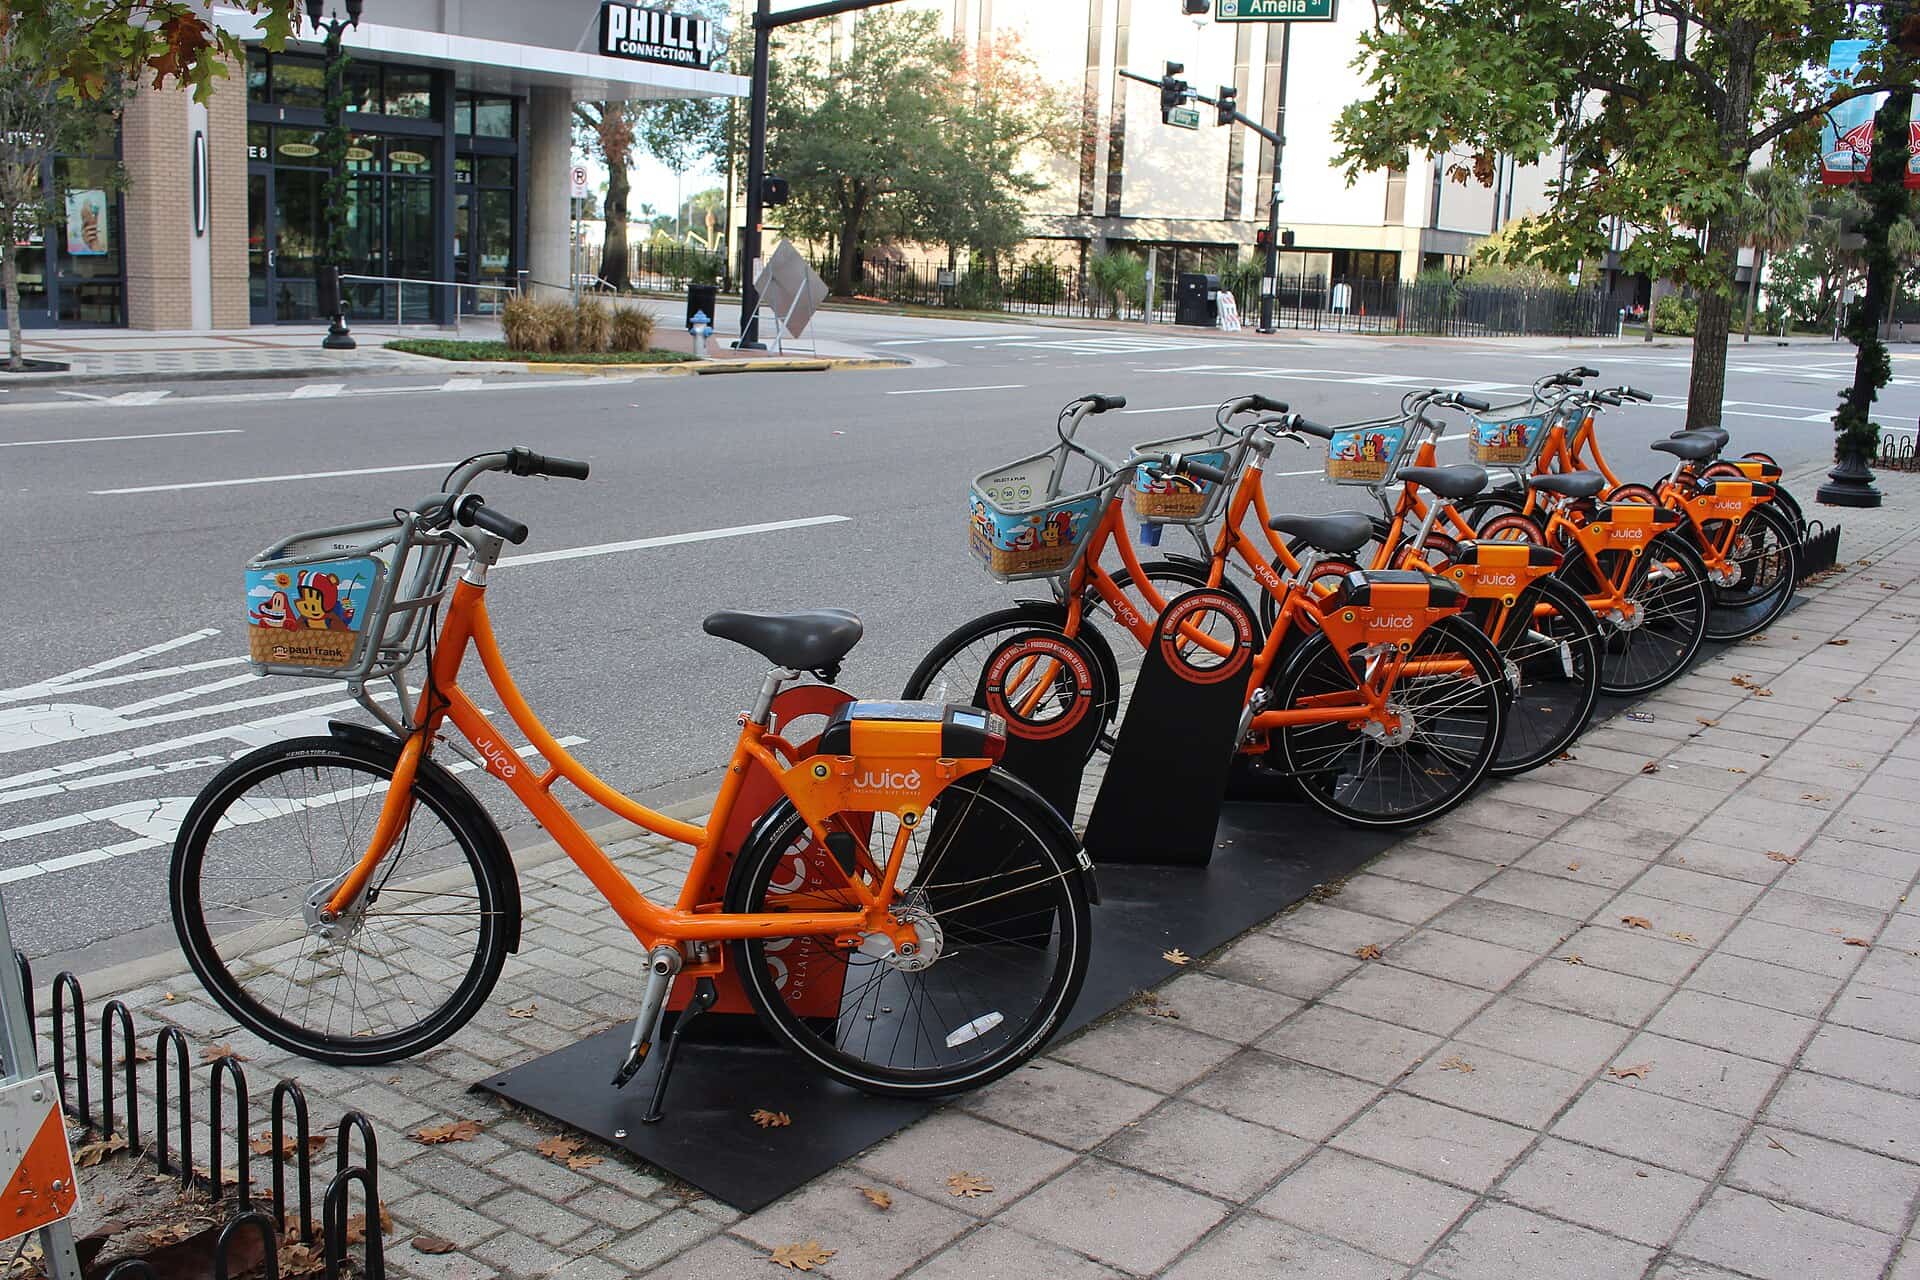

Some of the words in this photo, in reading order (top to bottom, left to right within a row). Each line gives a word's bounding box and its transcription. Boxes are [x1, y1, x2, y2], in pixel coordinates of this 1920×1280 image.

[1249, 0, 1307, 13] Amelia
[607, 4, 713, 65] PHILLY
[620, 41, 696, 63] CONNECTION
[314, 645, 343, 657] frank
